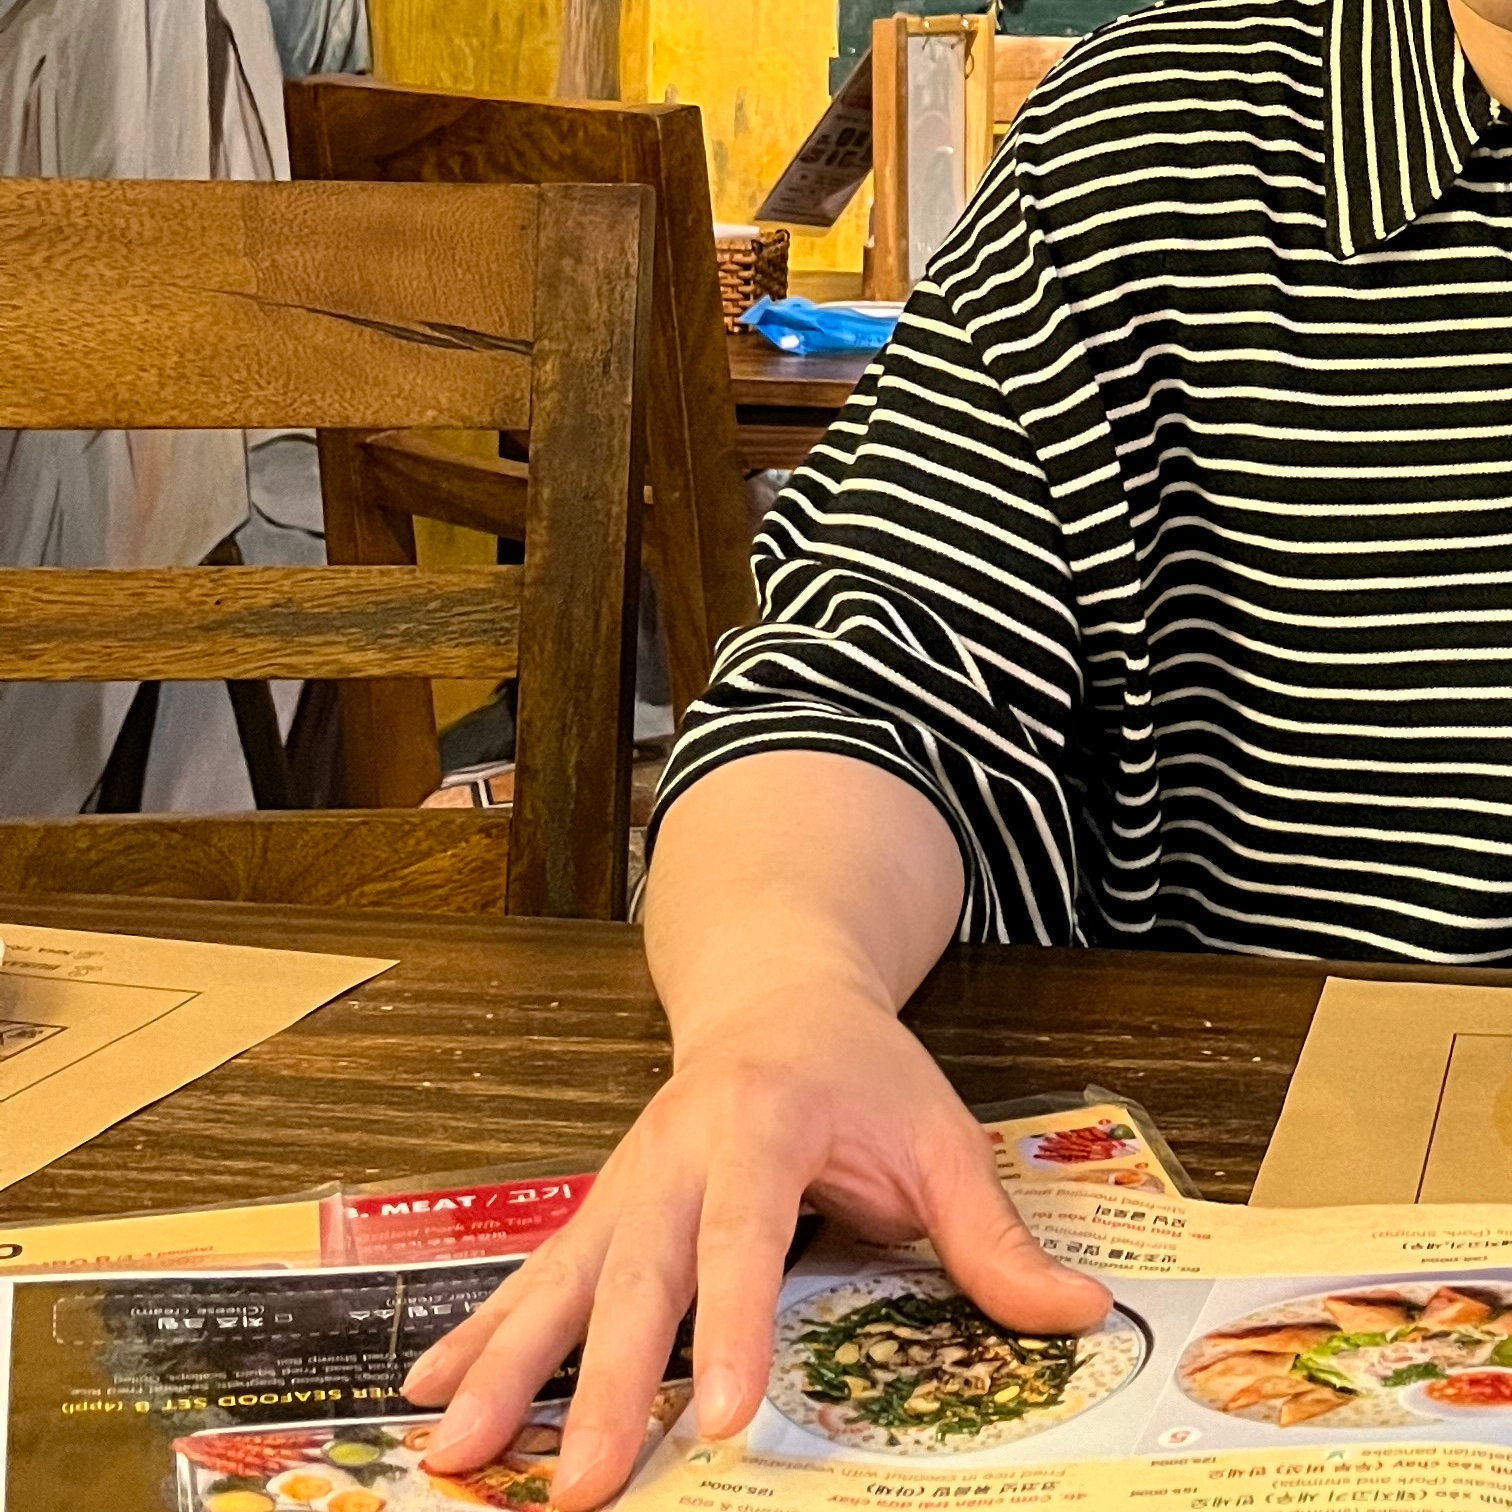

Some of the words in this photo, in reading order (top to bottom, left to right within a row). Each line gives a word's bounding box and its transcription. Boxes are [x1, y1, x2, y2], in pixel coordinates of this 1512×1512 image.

[381, 1196, 476, 1216] MEAT
[509, 1184, 571, 1204] 고기
[197, 1306, 264, 1316] (Cheese
[216, 1315, 263, 1328] 치즈
[162, 1397, 207, 1411] SET
[218, 1389, 342, 1406] SEAFOOD
[1357, 1477, 1390, 1486] and
